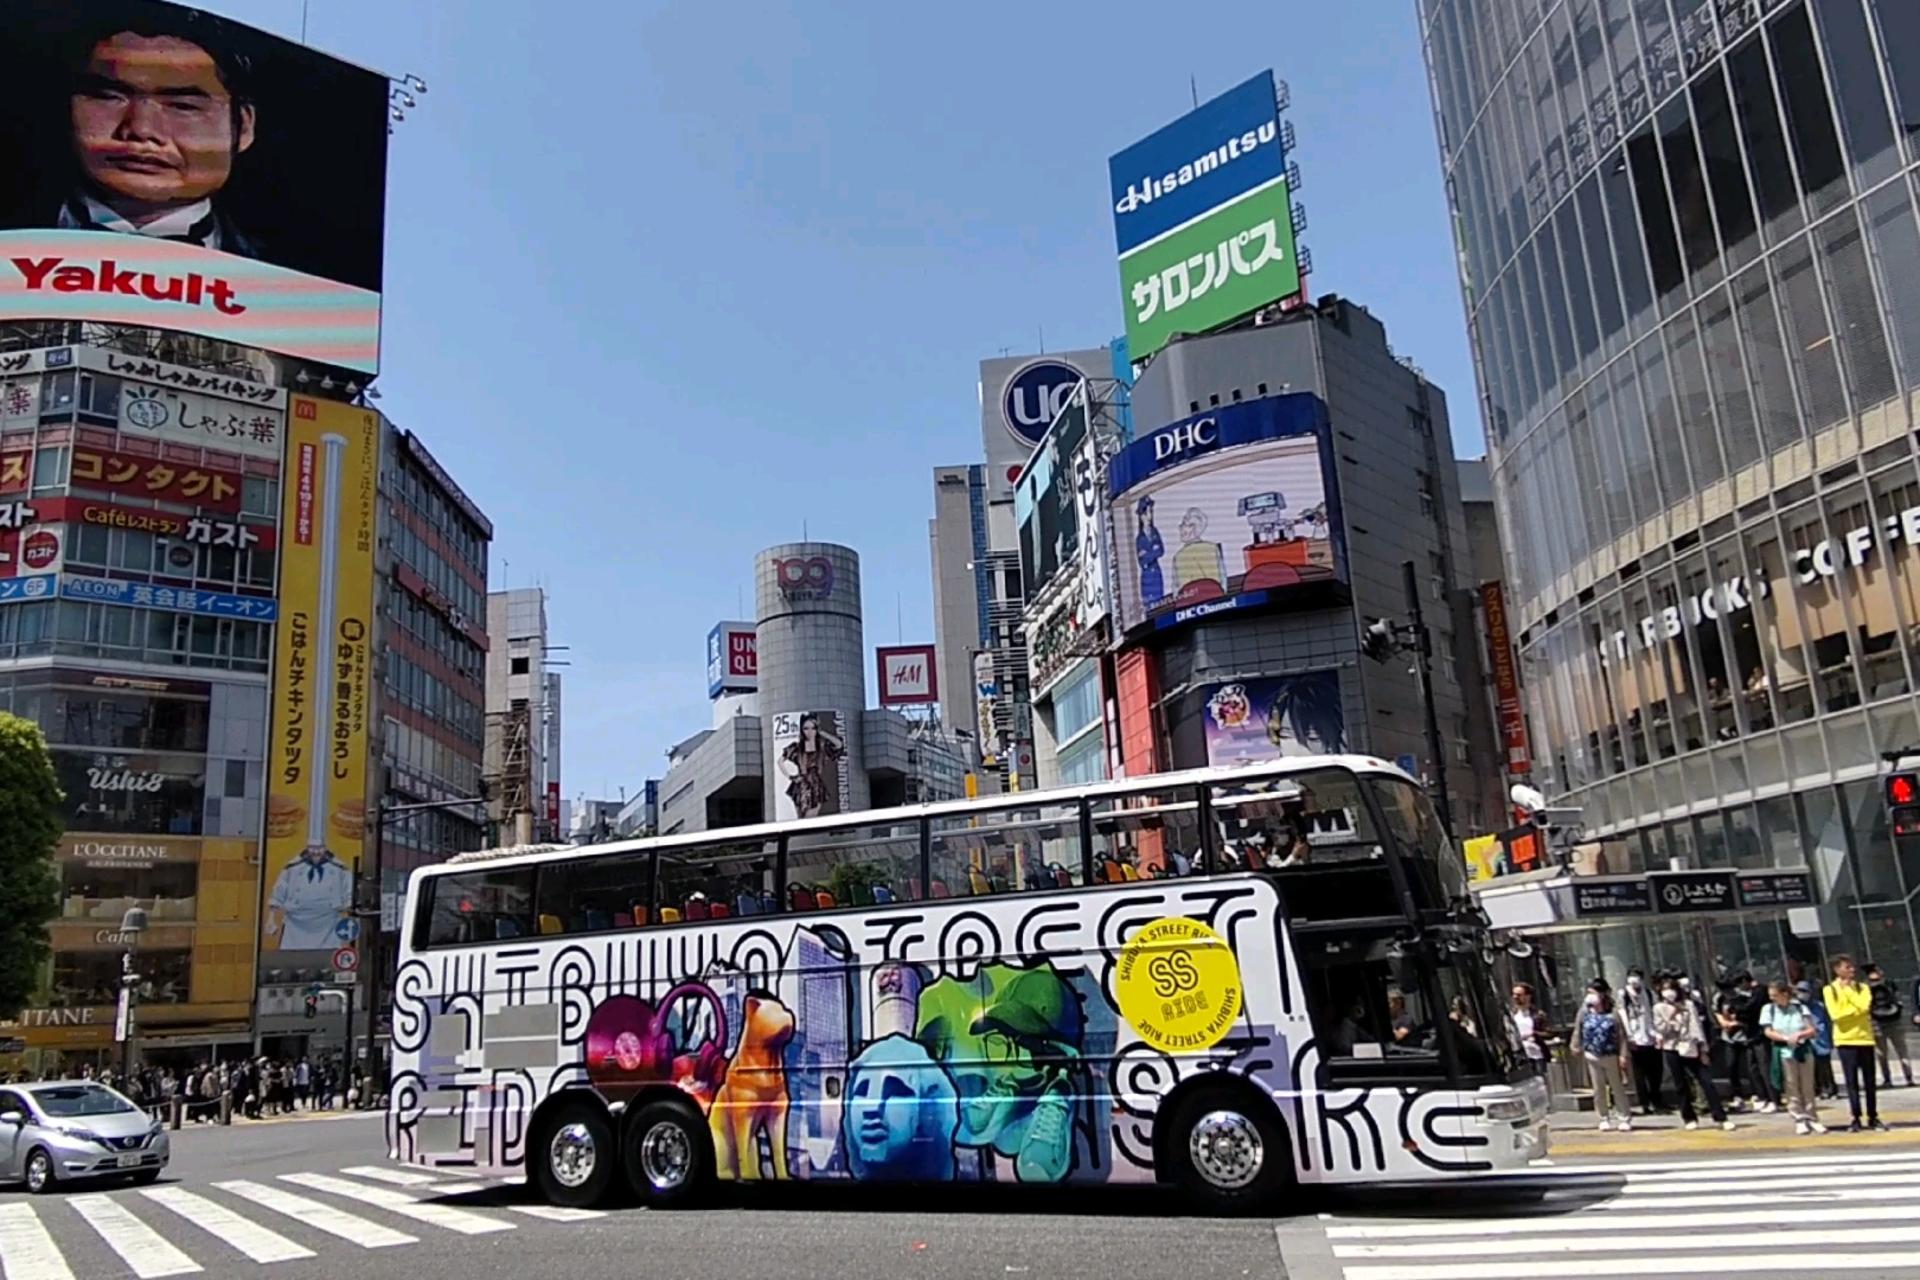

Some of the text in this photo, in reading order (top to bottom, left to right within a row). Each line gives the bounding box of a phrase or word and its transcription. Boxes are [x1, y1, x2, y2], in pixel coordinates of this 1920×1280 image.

[1115, 119, 1276, 213] Hisamitsu
[12, 258, 246, 315] Yakult
[1131, 219, 1283, 323] サロンパス
[108, 354, 277, 402] しゃぶしゃぶバイキング
[179, 402, 276, 443] しゃぶ葉
[1154, 418, 1218, 461] DHC
[73, 453, 236, 500] コンタクト
[186, 518, 259, 549] ガスト
[70, 578, 120, 597] AEON
[772, 557, 833, 597] 109
[1176, 606, 1196, 622] DHC
[1196, 597, 1237, 616] Channel
[733, 637, 757, 653] UN
[734, 655, 757, 673] QL
[893, 664, 921, 684] H&M
[73, 842, 168, 859] L'OCCITANE
[1149, 924, 1189, 940] STREET
[1149, 949, 1199, 998] SS
[1138, 987, 1236, 1047] SHIBUYA STREET RIDE
[1161, 991, 1209, 1022] RIDE
